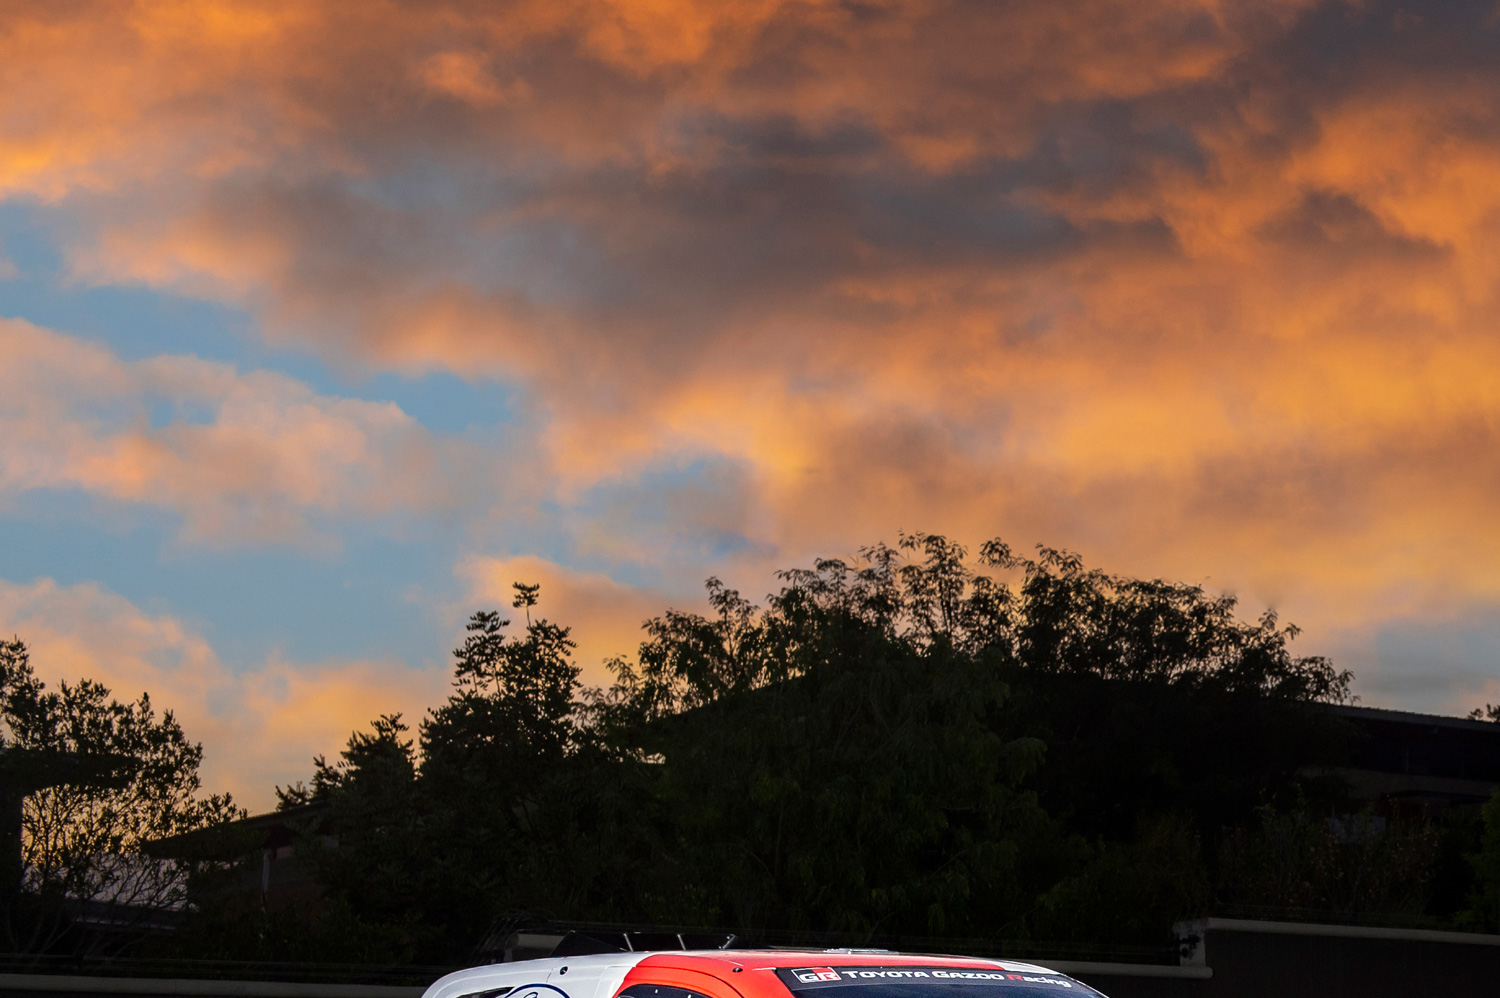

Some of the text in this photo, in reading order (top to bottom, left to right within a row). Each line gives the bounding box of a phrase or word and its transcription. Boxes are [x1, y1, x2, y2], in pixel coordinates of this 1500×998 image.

[841, 970, 930, 978] TOYOTA
[932, 971, 1005, 980] GAZOO
[1006, 974, 1072, 988] Racing
